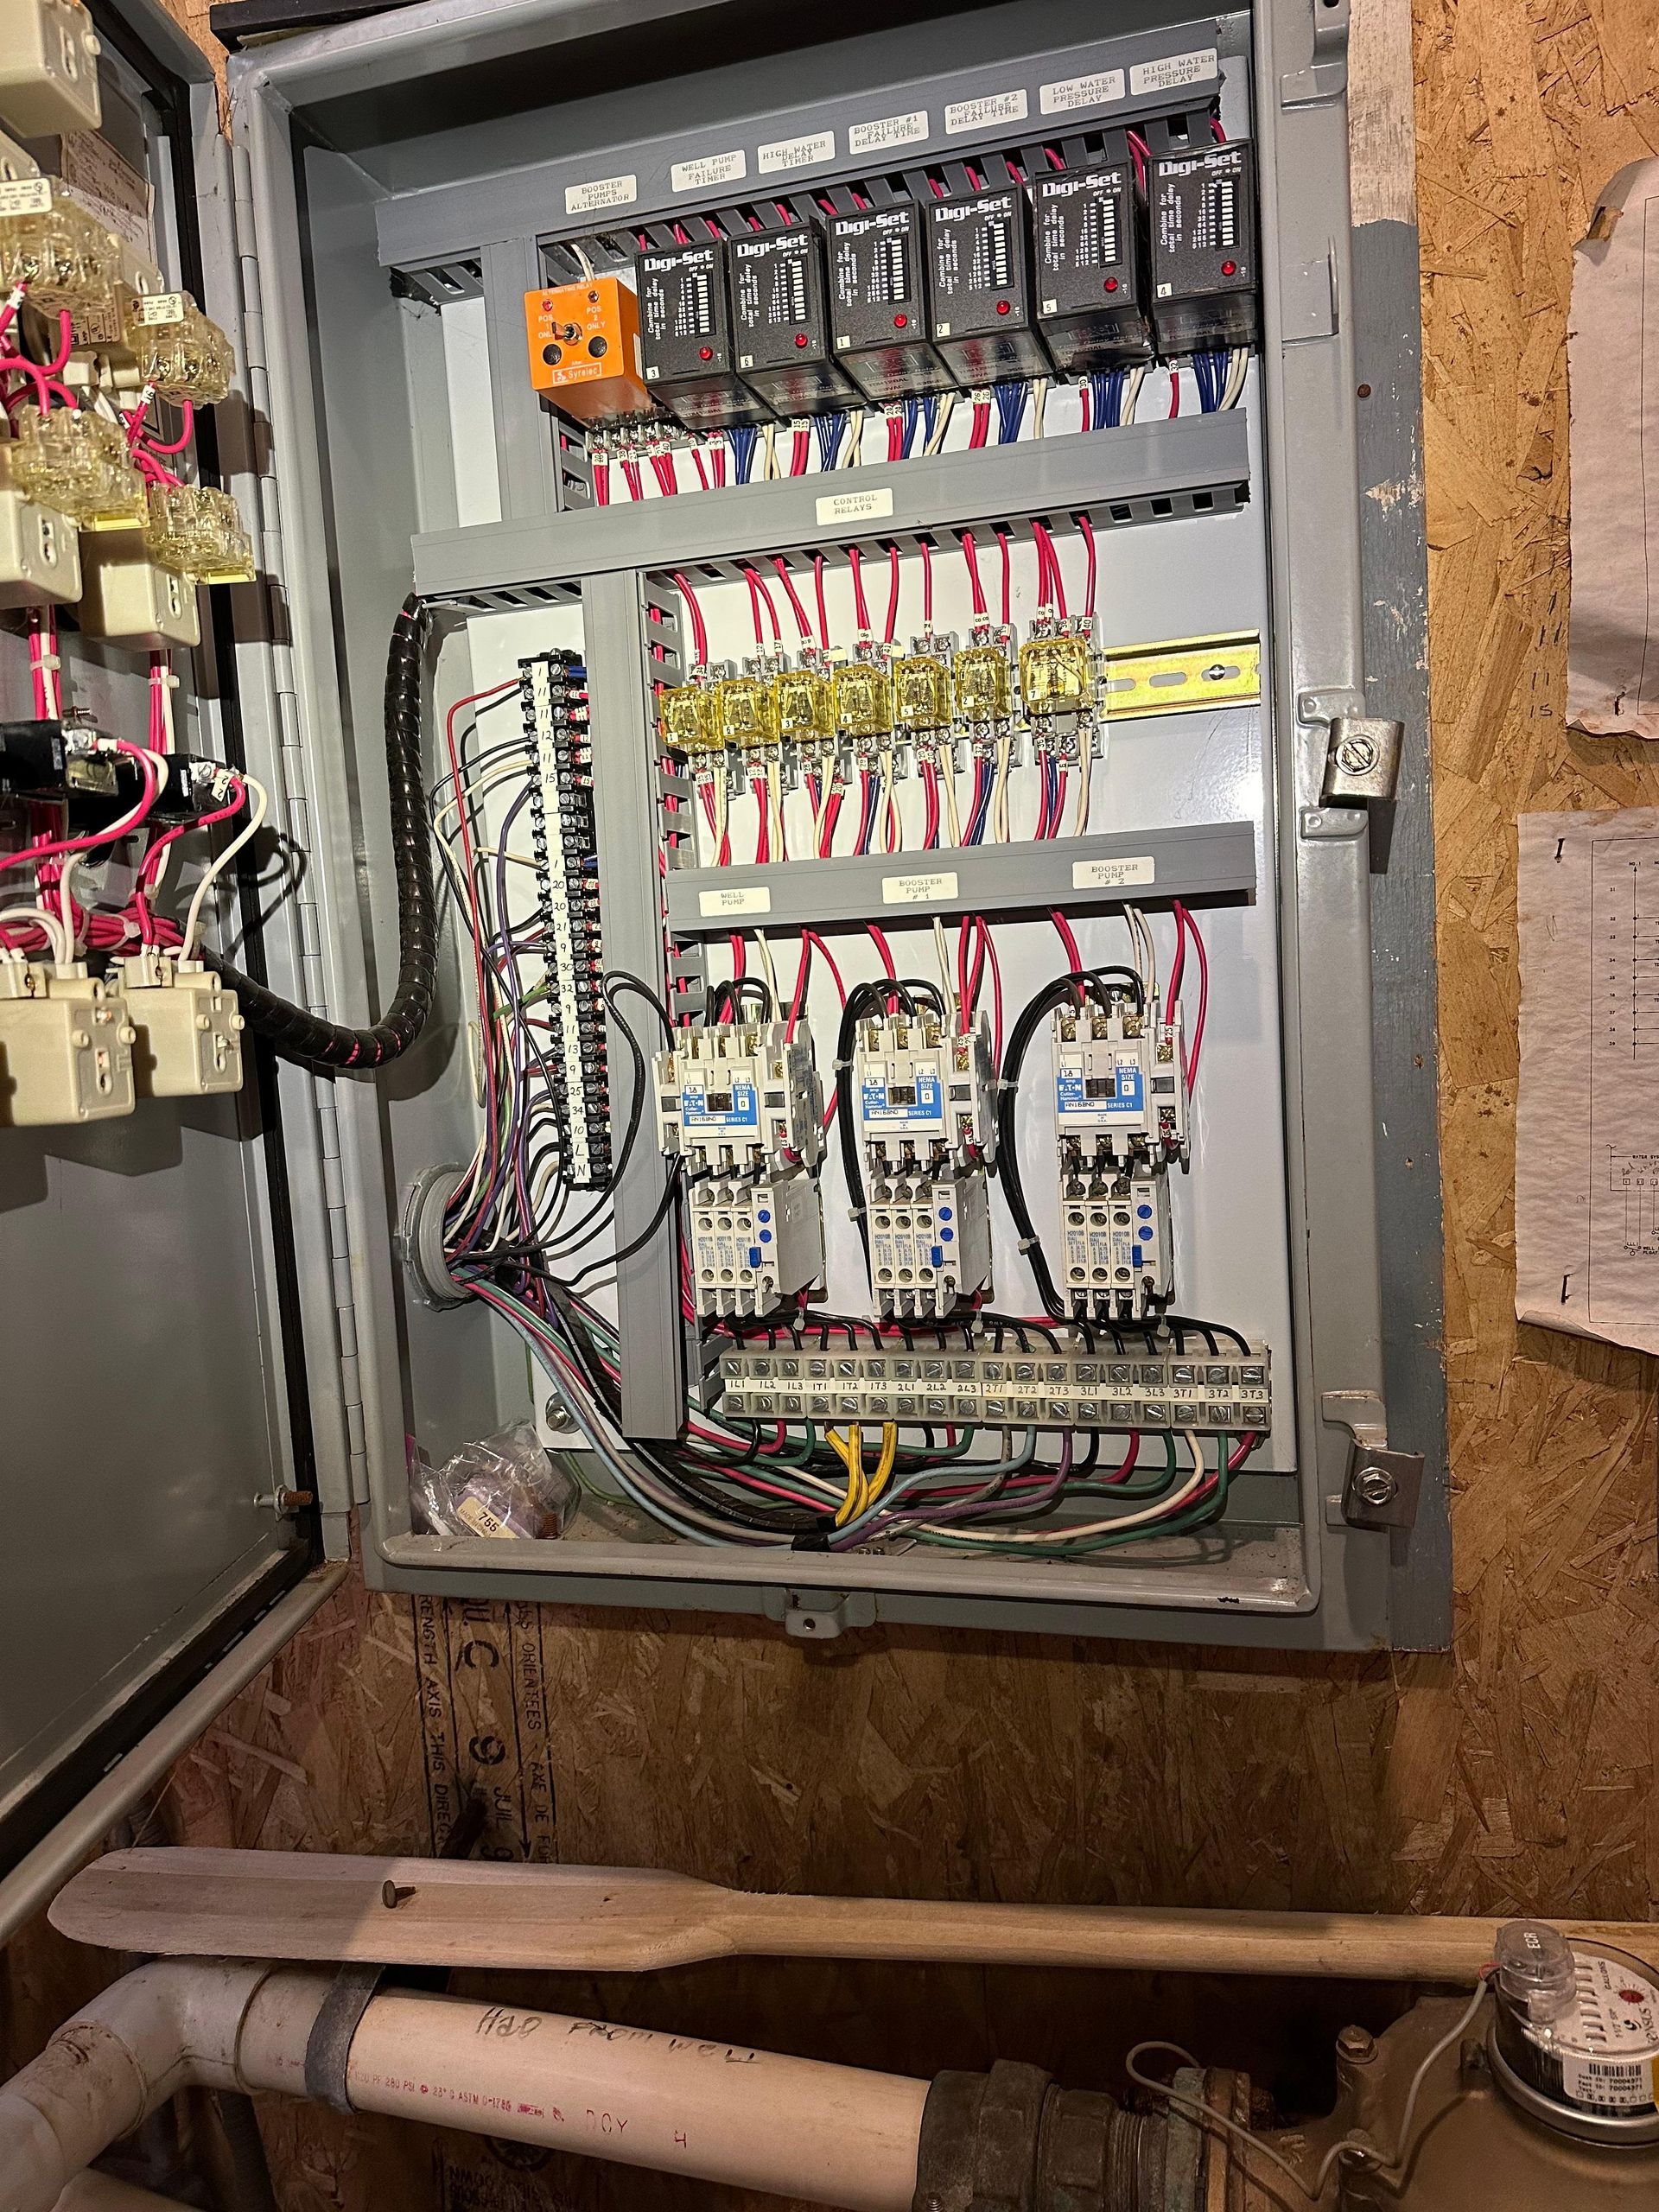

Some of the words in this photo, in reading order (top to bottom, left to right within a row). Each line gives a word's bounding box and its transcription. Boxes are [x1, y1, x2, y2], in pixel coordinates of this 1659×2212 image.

[1143, 63, 1171, 75] HIGH
[1179, 54, 1215, 67] WATER
[1143, 66, 1201, 84] PRESSURE
[1053, 86, 1073, 95] LOW
[1080, 76, 1116, 89] WATER
[1159, 74, 1193, 87] DELAY
[1053, 86, 1109, 103] PRESSURE
[950, 98, 997, 114] BOOSTER
[1004, 93, 1018, 102] #2
[1068, 95, 1102, 107] DELAY
[964, 103, 1012, 118] FAILURE
[950, 113, 983, 126] DELAY
[993, 106, 1019, 118] TIME
[854, 119, 899, 135] BOOSTER
[868, 124, 913, 138] FAILURE
[855, 135, 886, 147] DELAY
[896, 127, 920, 138] TIME
[763, 149, 788, 161] HIGH
[794, 140, 826, 154] WATER
[782, 149, 813, 161] DELAY
[682, 161, 706, 173] WELL
[712, 154, 736, 166] PUMP
[782, 155, 814, 167] TIMER
[688, 165, 731, 181] FAILURE
[695, 173, 726, 185] TIMER
[582, 181, 622, 194] BOOSTER
[588, 189, 617, 200] PUMPS
[571, 194, 629, 211] ALTERNATOR
[1160, 286, 1166, 296] 4
[1046, 303, 1052, 312] 5
[587, 321, 606, 331] ONLY
[938, 325, 944, 334] 2
[744, 357, 749, 366] 6
[568, 367, 597, 380] Syrelec
[833, 494, 877, 506] CONTROL
[834, 503, 872, 515] RELAYS
[1031, 691, 1035, 700] 7
[1530, 703, 1553, 718] 15
[842, 715, 848, 723] 4
[541, 731, 553, 741] 12
[545, 773, 556, 783] 15
[1091, 864, 1138, 873] BOOSTER
[552, 880, 565, 889] 20
[899, 878, 942, 887] BOOSTER
[554, 902, 566, 911] 20
[556, 922, 567, 931] 21
[560, 943, 567, 951] 9
[561, 963, 574, 972] 30
[561, 984, 574, 993] 32
[566, 1005, 571, 1014] 9
[569, 1045, 579, 1054] 13
[569, 1065, 575, 1074] 9
[570, 1087, 582, 1096] 25
[572, 1107, 584, 1116] 34
[574, 1125, 584, 1134] 10
[575, 1144, 585, 1157] L
[576, 1164, 586, 1178] N
[730, 1380, 745, 1389] 1L1
[759, 1380, 776, 1389] 1L2
[787, 1382, 804, 1391] 1L3
[812, 1382, 827, 1391] 1T1
[842, 1382, 859, 1391] 1T2
[870, 1382, 887, 1391] 1T3
[898, 1382, 915, 1392] 2L1
[925, 1382, 947, 1392] 2L2
[957, 1384, 976, 1393] 2L3
[985, 1385, 1002, 1394] 2T1
[1017, 1386, 1037, 1395] 2T2
[1049, 1386, 1069, 1395] 2T3
[1080, 1386, 1098, 1396] 3L1
[1112, 1386, 1133, 1396] 3L2
[1145, 1387, 1166, 1398] 3L3
[1173, 1389, 1192, 1398] 3T1
[1209, 1389, 1230, 1399] 3T2
[1241, 1389, 1263, 1400] 3T3
[478, 1512, 499, 1532] 755
[464, 1641, 499, 1669] C
[520, 1643, 541, 1730] ORIENTEES
[425, 1677, 442, 1719] AXIS
[429, 1731, 446, 1771] THIS
[529, 1761, 547, 1793] AXE
[458, 2090, 479, 2105] ASTM
